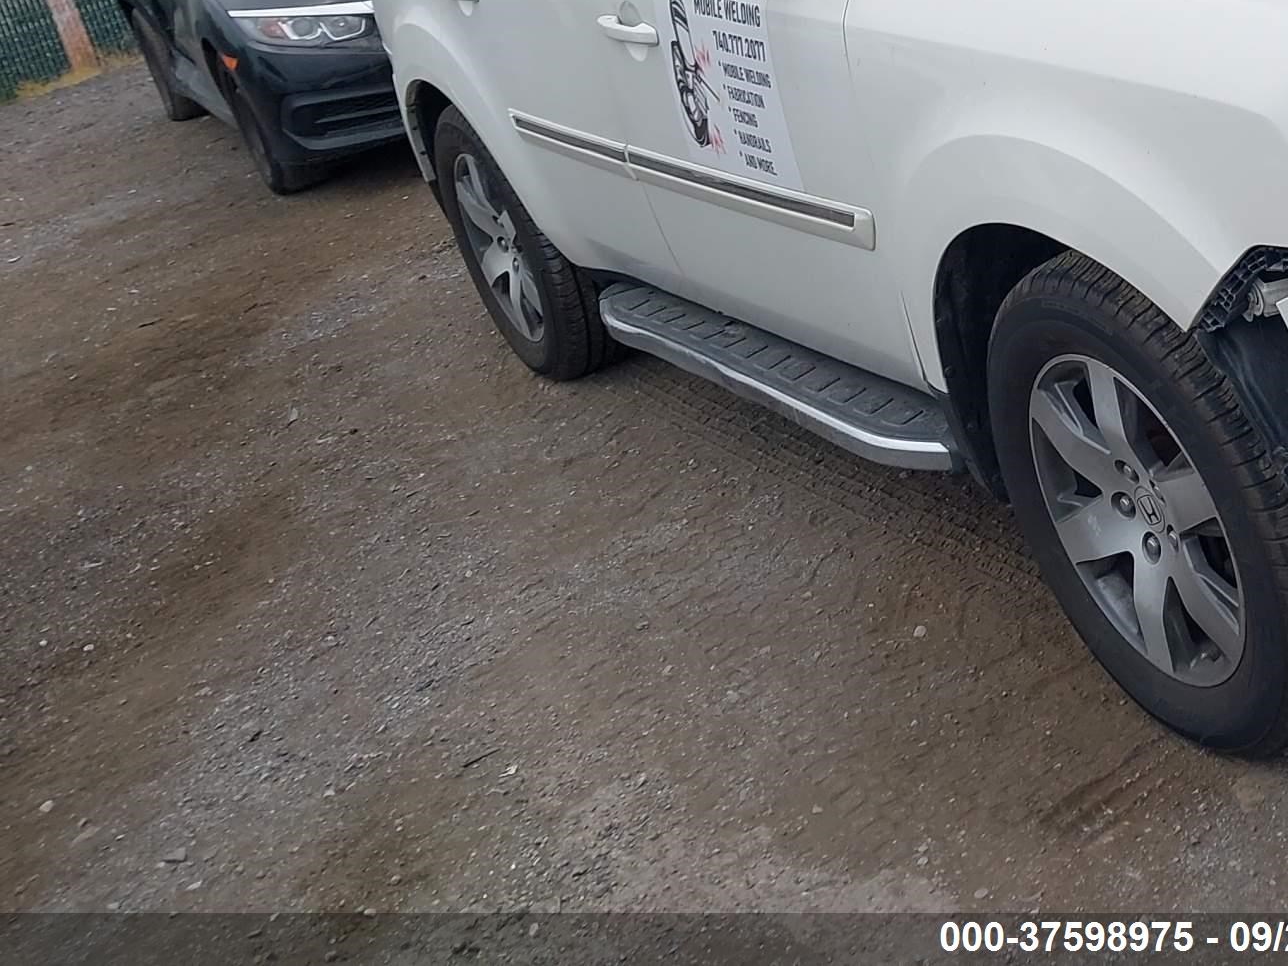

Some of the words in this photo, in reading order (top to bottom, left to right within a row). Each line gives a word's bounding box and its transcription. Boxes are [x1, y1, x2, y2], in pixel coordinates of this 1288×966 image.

[712, 30, 766, 62] 740.777.2077
[722, 63, 745, 81] MOBILE
[744, 68, 771, 88] WELDING
[727, 86, 765, 108] FABRICATION
[732, 108, 759, 128] FENCING
